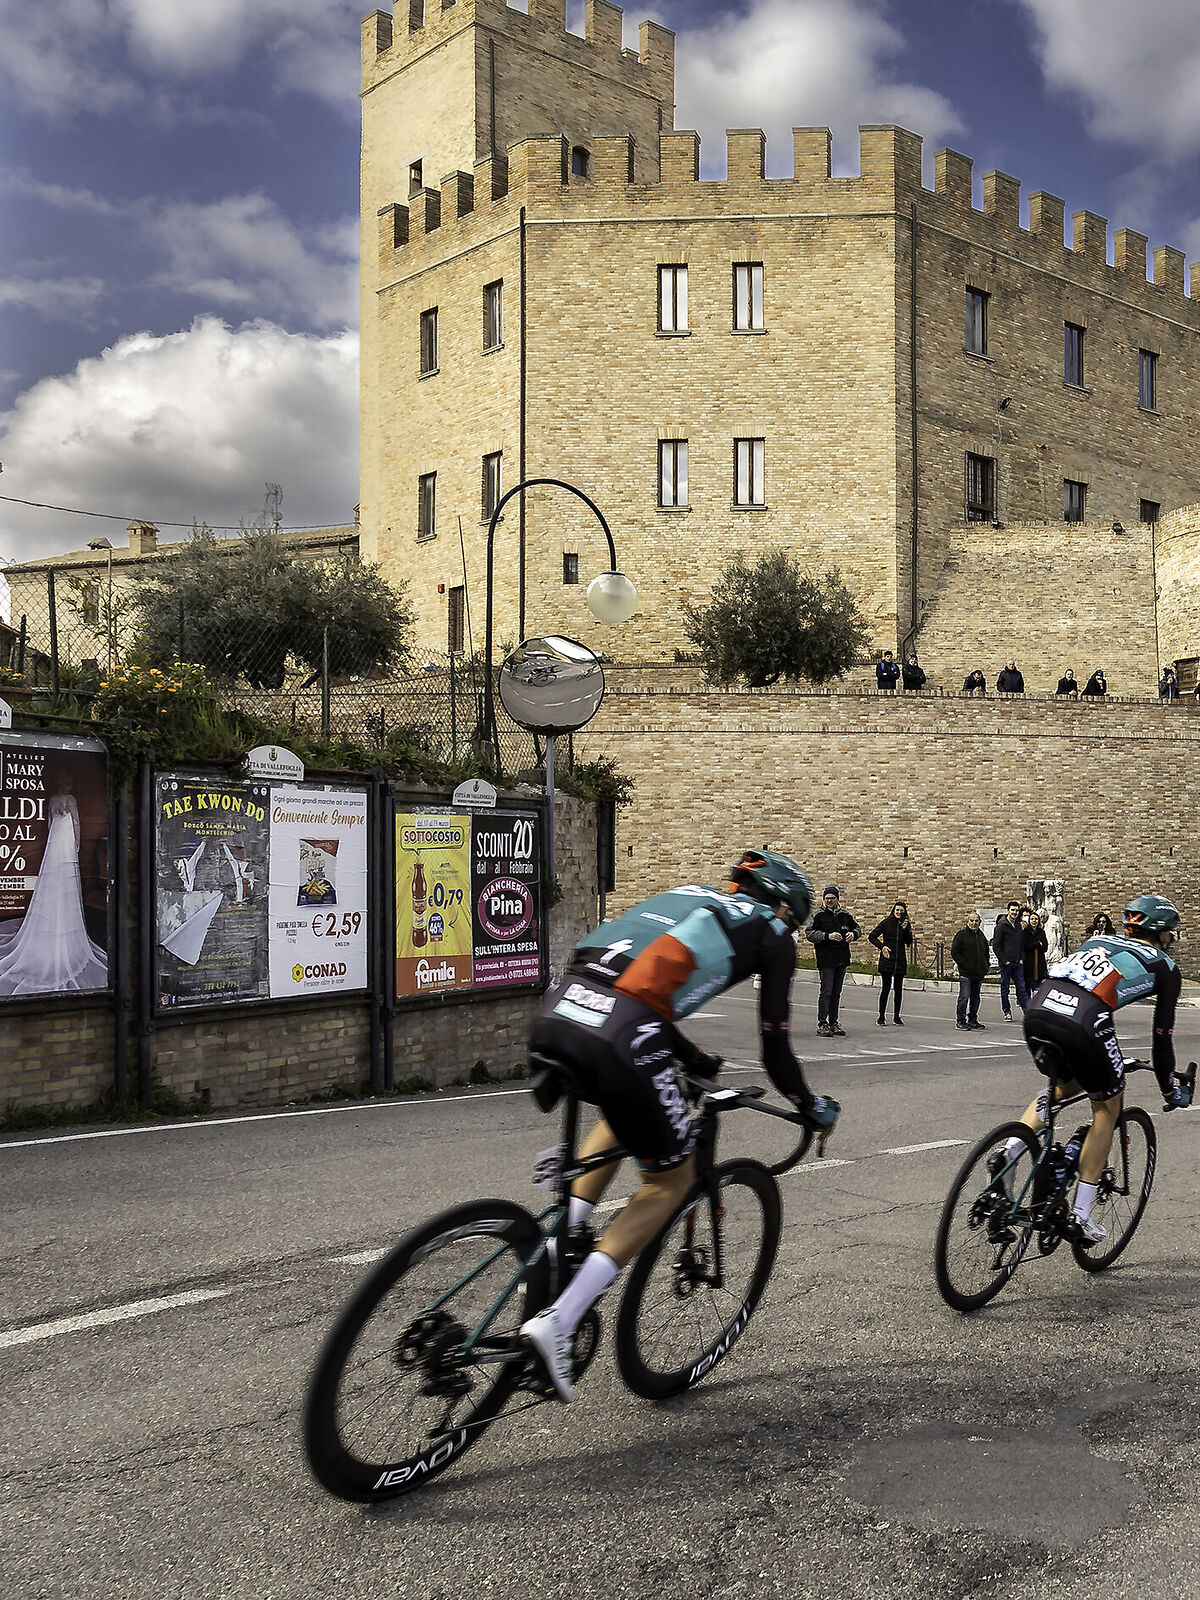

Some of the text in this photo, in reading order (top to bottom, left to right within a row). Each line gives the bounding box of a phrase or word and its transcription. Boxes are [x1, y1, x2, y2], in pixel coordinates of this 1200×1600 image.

[7, 763, 45, 776] MARY
[267, 763, 301, 772] VALLEFOGLIA
[6, 778, 45, 791] SPOSA
[163, 793, 265, 822] TAE KWON DO
[286, 796, 301, 804] giorno
[302, 797, 317, 805] grandi
[272, 806, 365, 829] Conveniente Sempre
[13, 824, 37, 841] AL
[404, 830, 461, 843] SOTTOCOSTO
[476, 832, 512, 858] SCONTI
[476, 861, 486, 874] dal
[494, 861, 501, 874] al
[509, 861, 533, 874] Febbraio
[428, 882, 464, 910] €0,79
[482, 880, 528, 901] BIANCHERIA
[491, 894, 523, 916] Pina
[311, 911, 361, 939] €2,59
[429, 921, 443, 934] 46%
[474, 941, 538, 956] SULL'INTERA SPESA
[304, 962, 347, 979] CONAD
[414, 959, 456, 989] famila
[1046, 988, 1079, 1007] BORA
[1103, 1036, 1125, 1079] BORA
